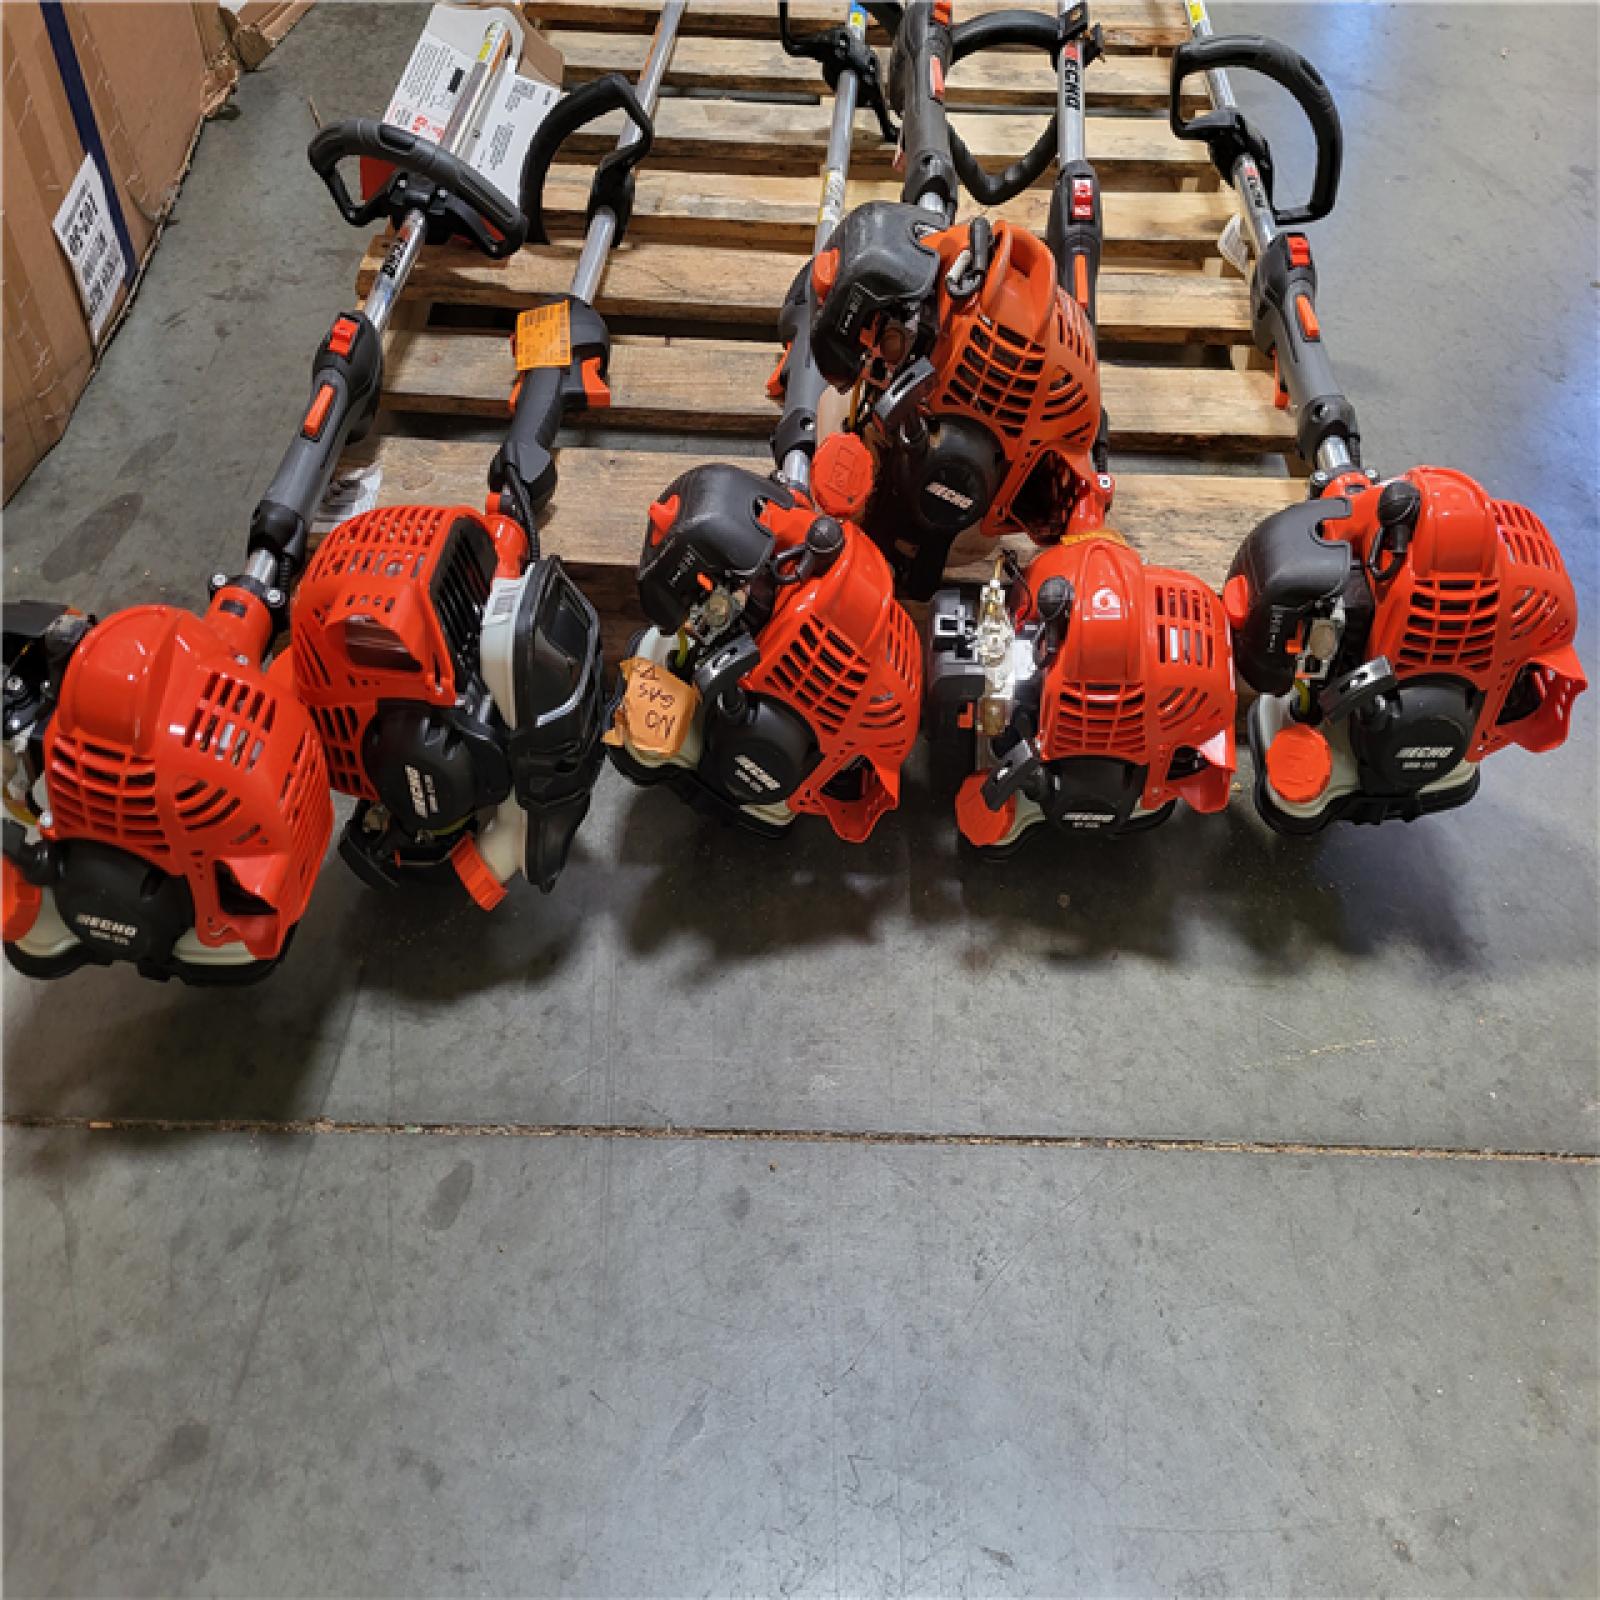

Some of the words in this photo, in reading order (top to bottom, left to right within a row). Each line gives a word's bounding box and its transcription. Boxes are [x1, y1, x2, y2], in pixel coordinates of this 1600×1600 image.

[1064, 58, 1081, 111] ECHO
[932, 483, 973, 510] ECHO
[638, 682, 676, 710] GAS
[644, 709, 676, 740] NO
[1403, 746, 1453, 758] ECHO
[404, 764, 424, 808] ECHO
[742, 757, 781, 791] ECHO
[89, 914, 137, 936] ECHO
